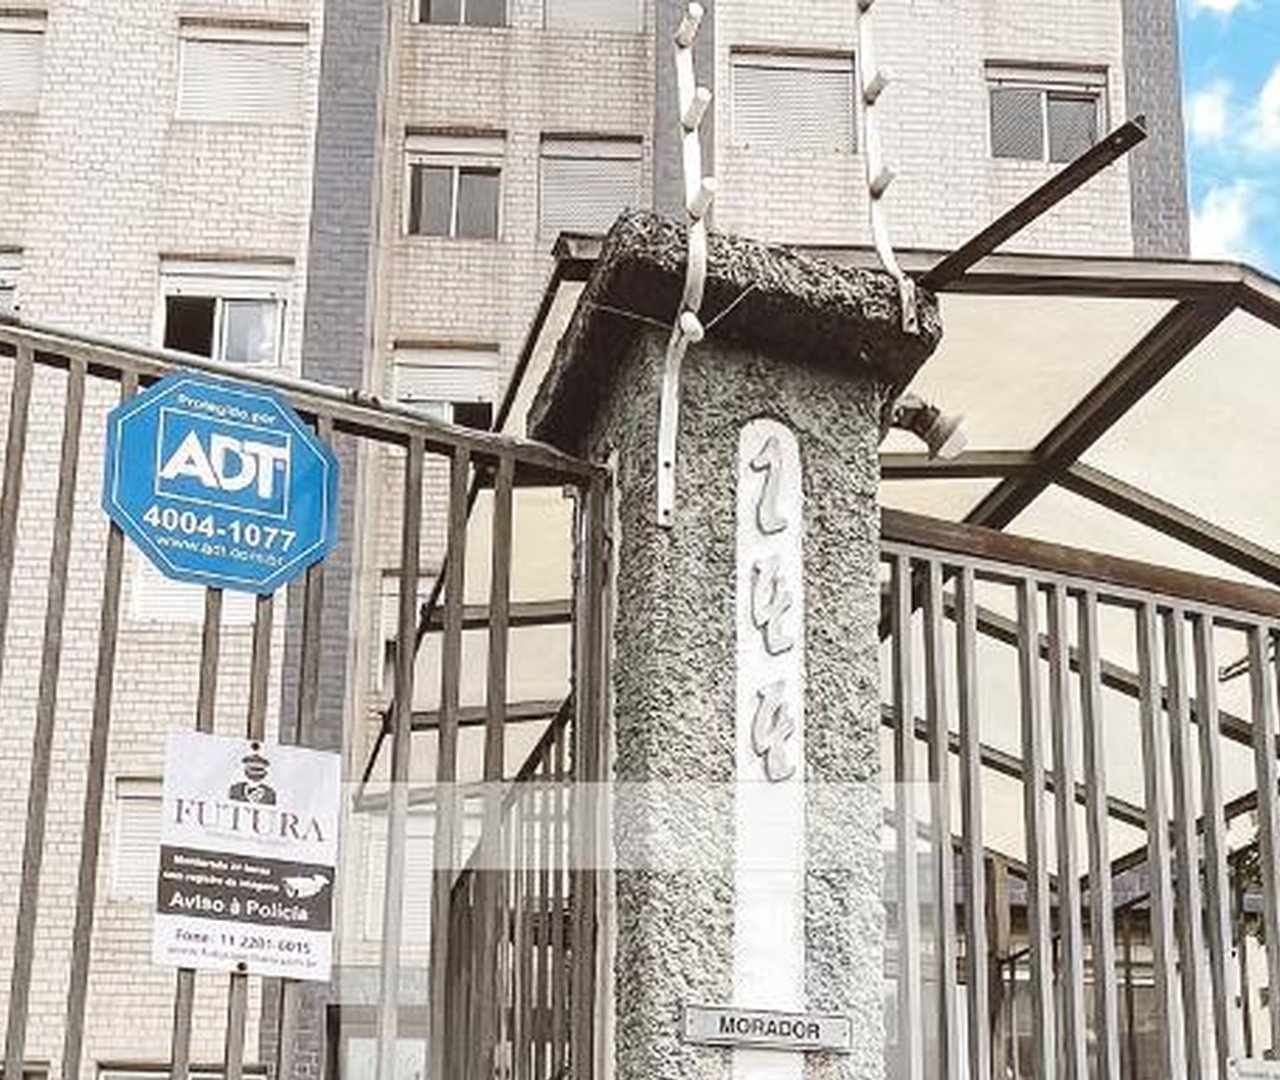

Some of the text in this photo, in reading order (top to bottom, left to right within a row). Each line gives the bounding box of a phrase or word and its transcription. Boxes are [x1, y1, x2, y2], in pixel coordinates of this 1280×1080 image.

[160, 430, 288, 499] ADT
[143, 505, 297, 552] 4004-1077
[175, 798, 328, 843] FUTURA
[169, 890, 224, 912] Aviso
[719, 1015, 821, 1040] MORADOR
